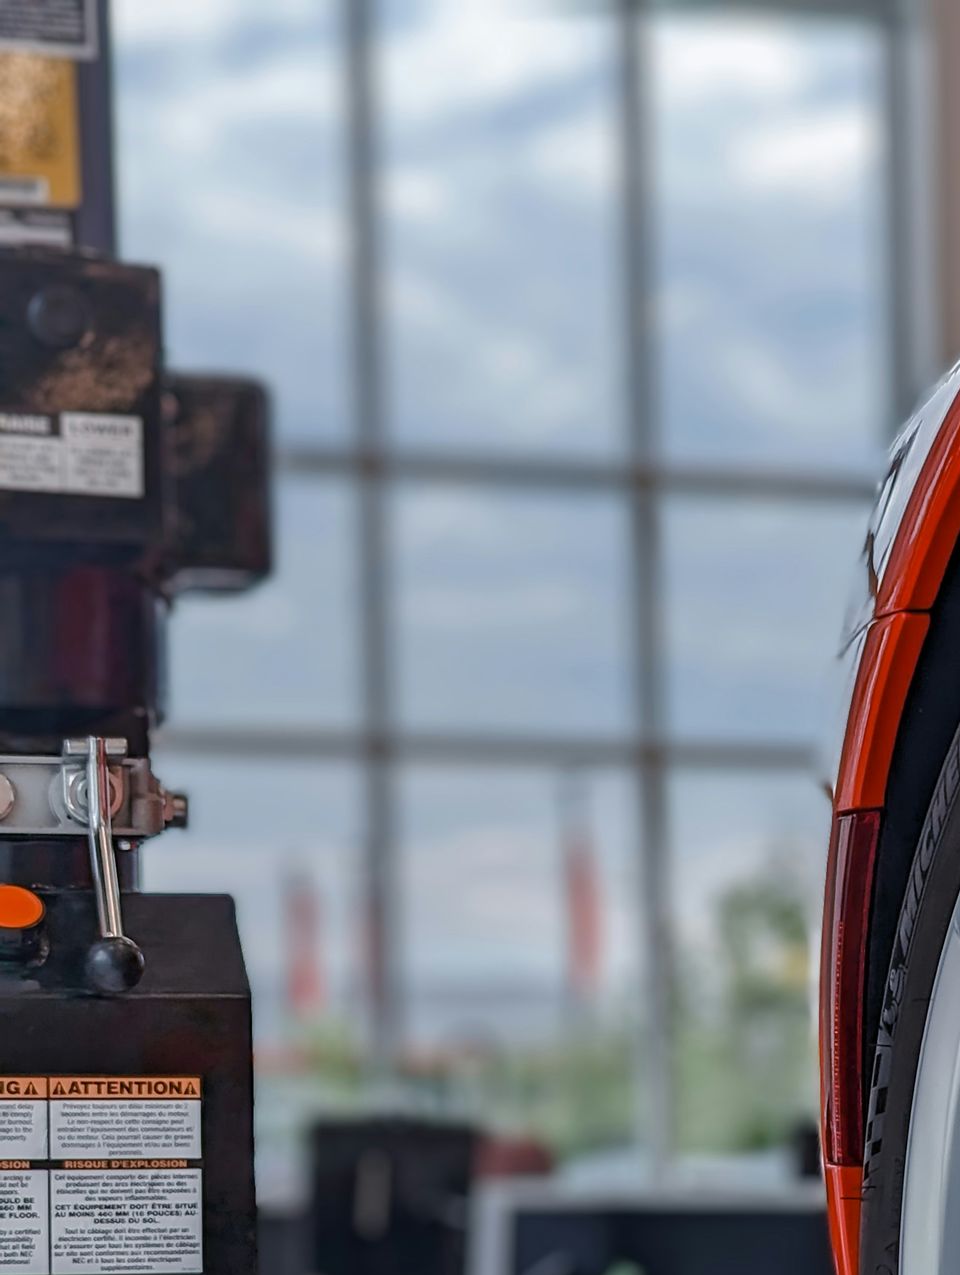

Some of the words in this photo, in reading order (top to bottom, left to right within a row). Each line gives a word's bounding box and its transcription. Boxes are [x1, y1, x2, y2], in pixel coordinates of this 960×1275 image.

[68, 1081, 182, 1095] ATTENTION
[0, 1160, 30, 1169] SION
[64, 1160, 108, 1169] RISQUE
[111, 1159, 188, 1168] D'EXPLOSION
